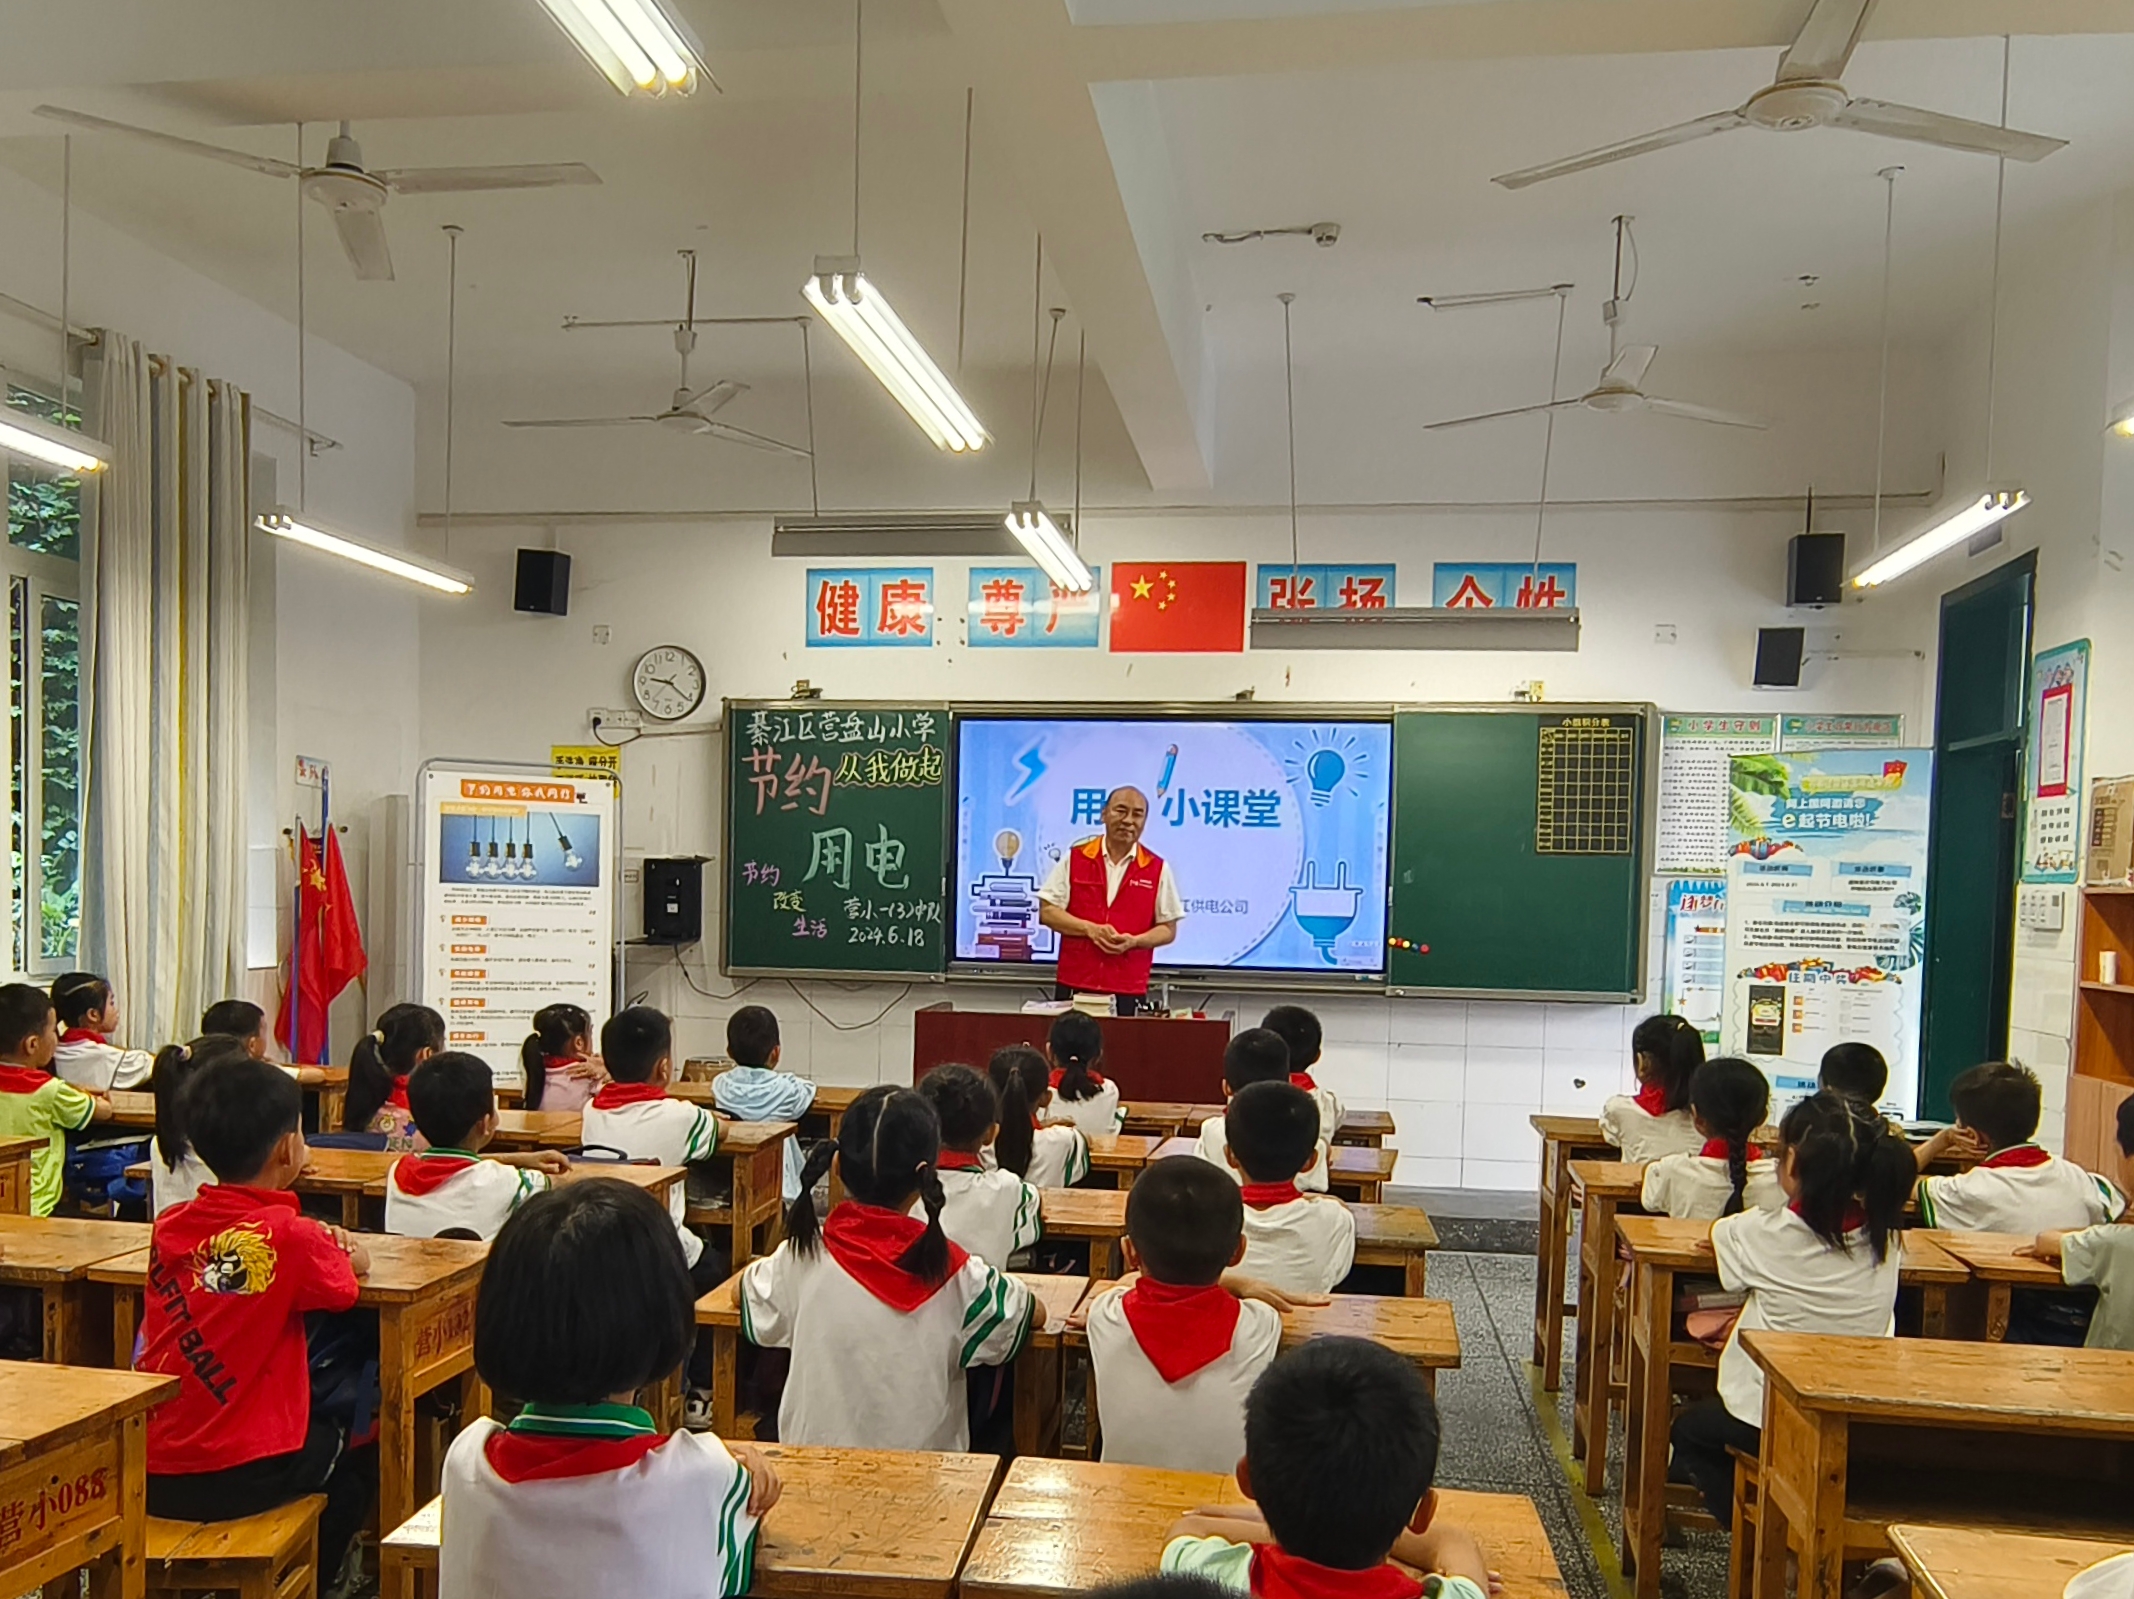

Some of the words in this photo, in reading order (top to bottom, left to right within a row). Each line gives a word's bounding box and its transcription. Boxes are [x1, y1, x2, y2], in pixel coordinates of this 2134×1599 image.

[816, 579, 926, 636] 健康
[1688, 720, 1761, 732] 小学生守则
[741, 746, 832, 816] 节约
[836, 747, 943, 783] 从我做起
[801, 823, 910, 890] 用电
[742, 859, 781, 887] 节约
[773, 891, 804, 912] 改变
[792, 917, 829, 939] 生活
[848, 925, 925, 947] 2024.6.18
[178, 1328, 238, 1408] BALL
